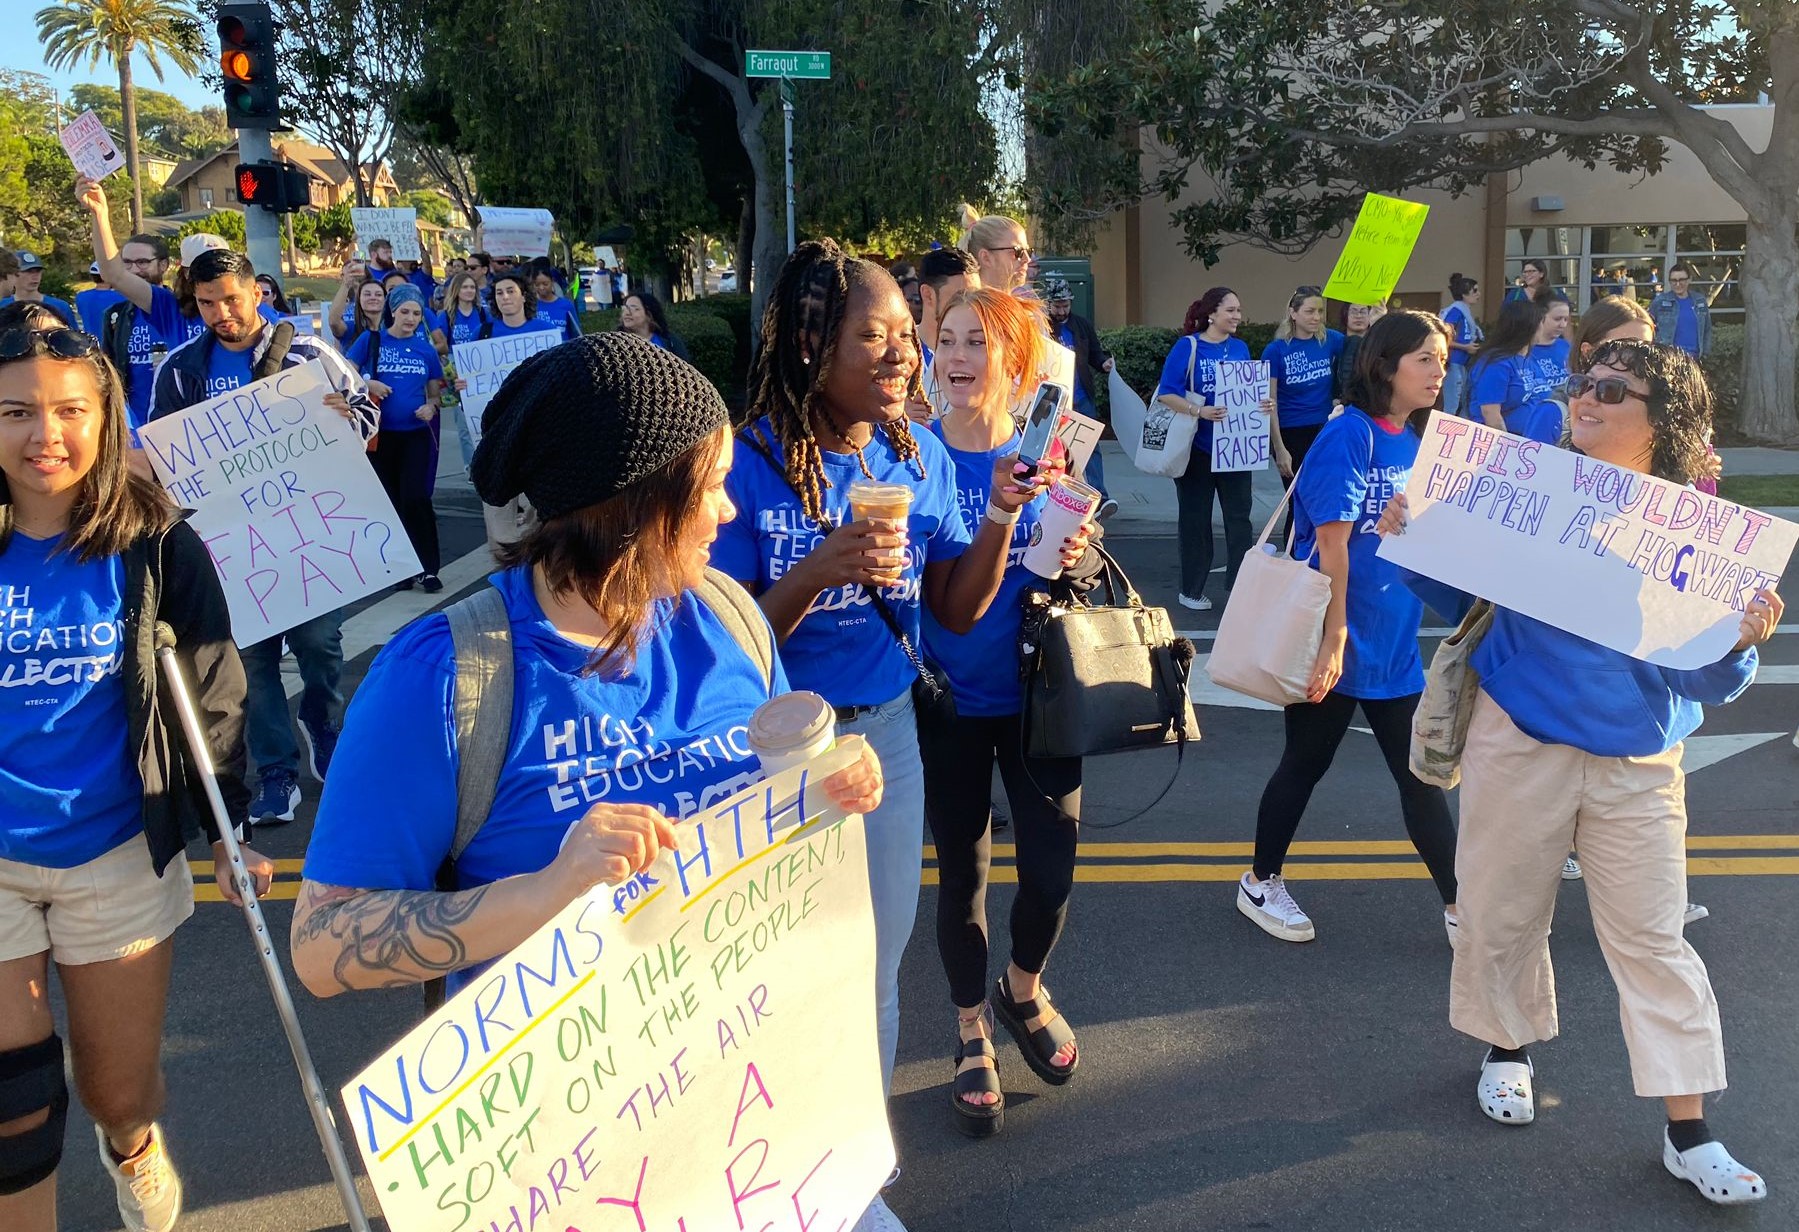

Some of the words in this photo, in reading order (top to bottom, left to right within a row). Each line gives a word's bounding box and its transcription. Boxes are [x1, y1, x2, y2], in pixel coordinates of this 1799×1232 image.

[751, 54, 799, 74] Farragut
[1338, 255, 1372, 291] Why
[457, 346, 482, 375] NO
[1218, 384, 1268, 408] TUNE
[1220, 360, 1270, 387] PROJECT
[1286, 358, 1331, 376] EDUCATION
[145, 374, 306, 476] WHERE'S
[167, 469, 211, 507] THE
[219, 423, 338, 485] PROTOCOL
[1216, 434, 1270, 470] RAISE
[240, 470, 306, 515] FOR
[1425, 462, 1550, 537] HAPPEN
[1560, 504, 1629, 558] AT
[1436, 418, 1542, 481] THIS
[1574, 456, 1772, 555] WOULDN'T
[203, 490, 368, 582] FAIR
[245, 520, 392, 625] PAY?
[543, 713, 655, 761] HIGH
[547, 724, 753, 814] EDUCATIO
[358, 900, 603, 1154] NORMS
[673, 769, 809, 897] HTH
[406, 1051, 533, 1190] HARD
[557, 984, 607, 1062] ON
[622, 920, 691, 1006] THE
[437, 1106, 541, 1232] SOFT
[567, 1045, 617, 1114] ON
[638, 982, 700, 1047] THE
[710, 877, 823, 990] PEOPLE
[477, 1126, 602, 1232] HARE
[616, 1047, 696, 1132] THE
[717, 983, 773, 1060] AIR
